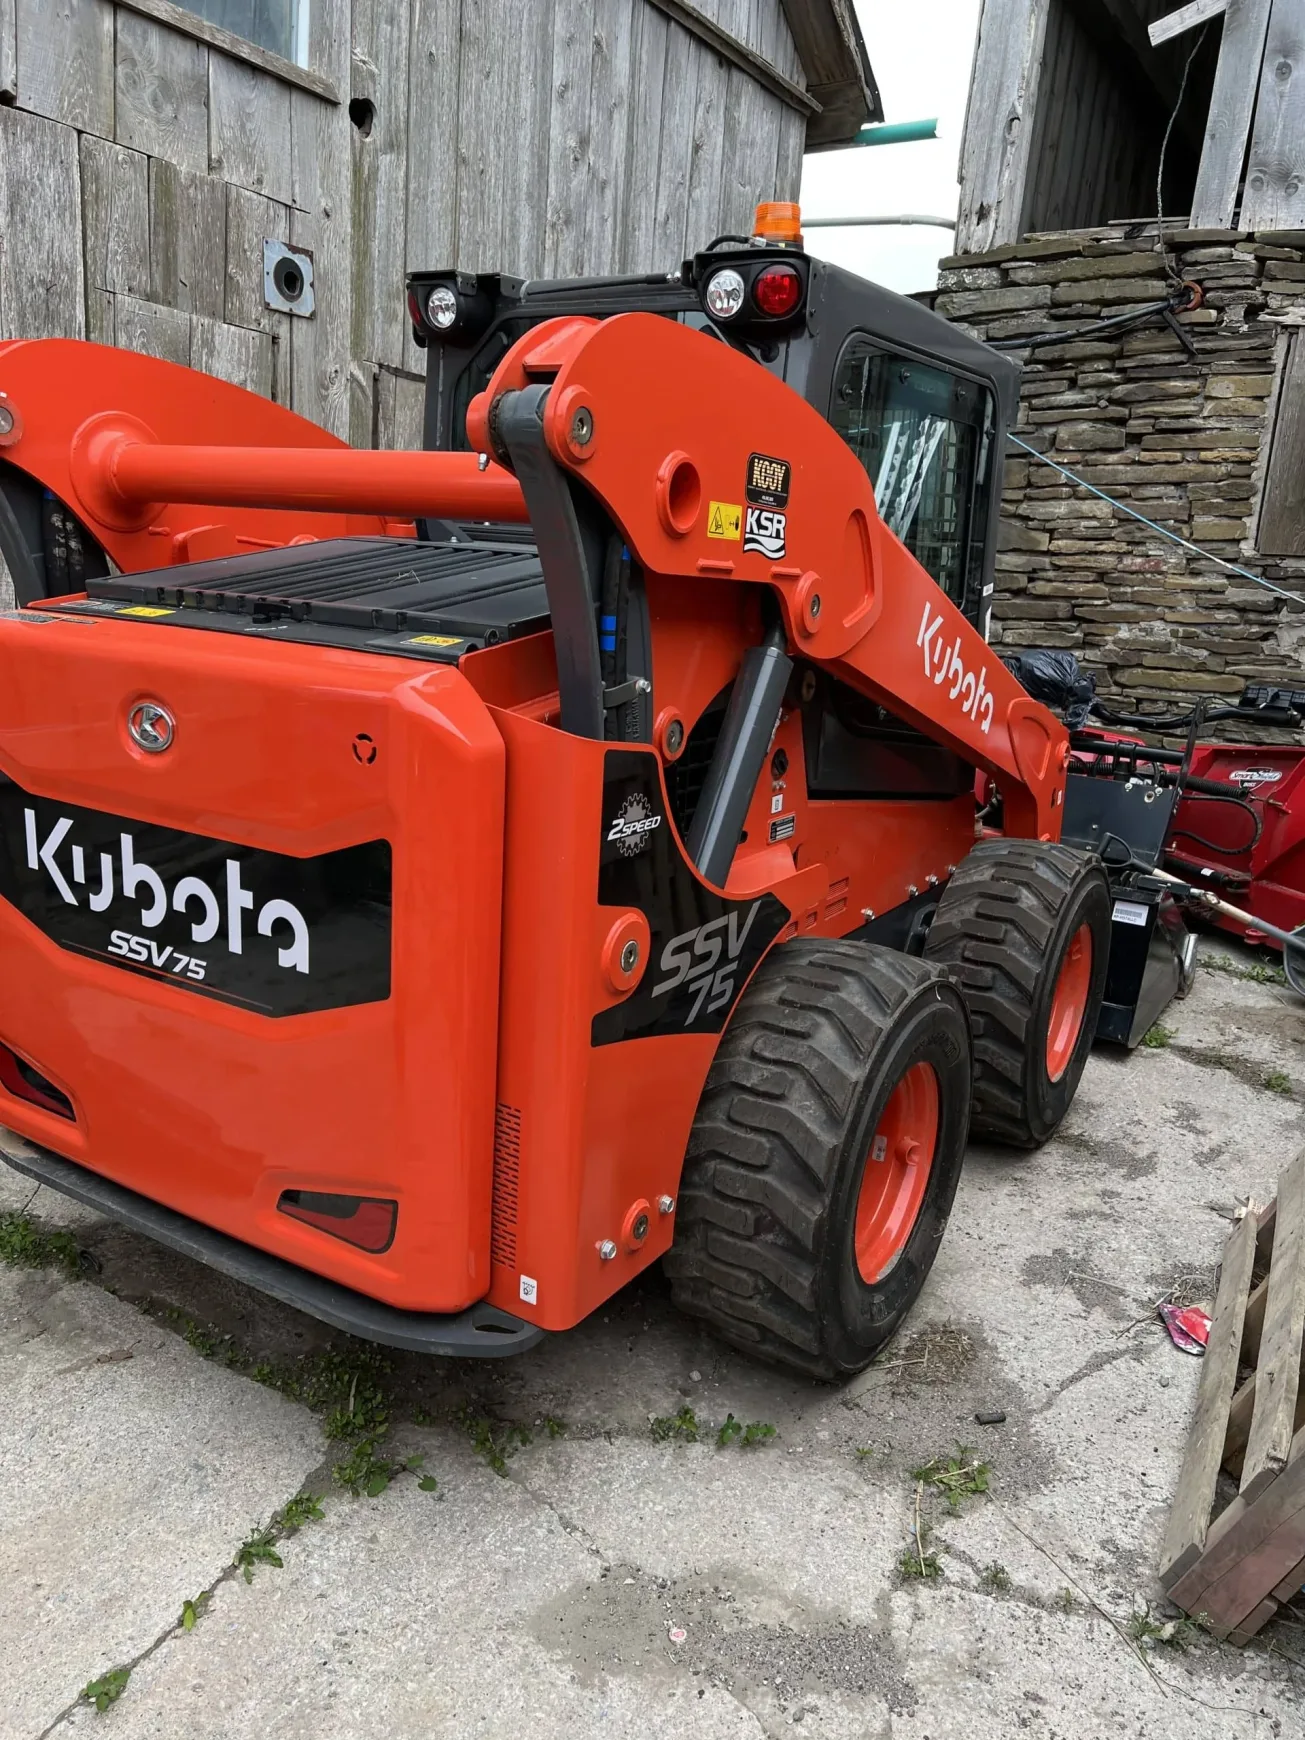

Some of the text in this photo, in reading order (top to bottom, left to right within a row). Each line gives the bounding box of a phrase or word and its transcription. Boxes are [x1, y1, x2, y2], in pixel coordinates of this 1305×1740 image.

[745, 508, 787, 539] KSR
[916, 600, 994, 735] Kubota
[24, 807, 310, 974] Kubota
[651, 900, 762, 999] SSV
[683, 960, 739, 1027] 75
